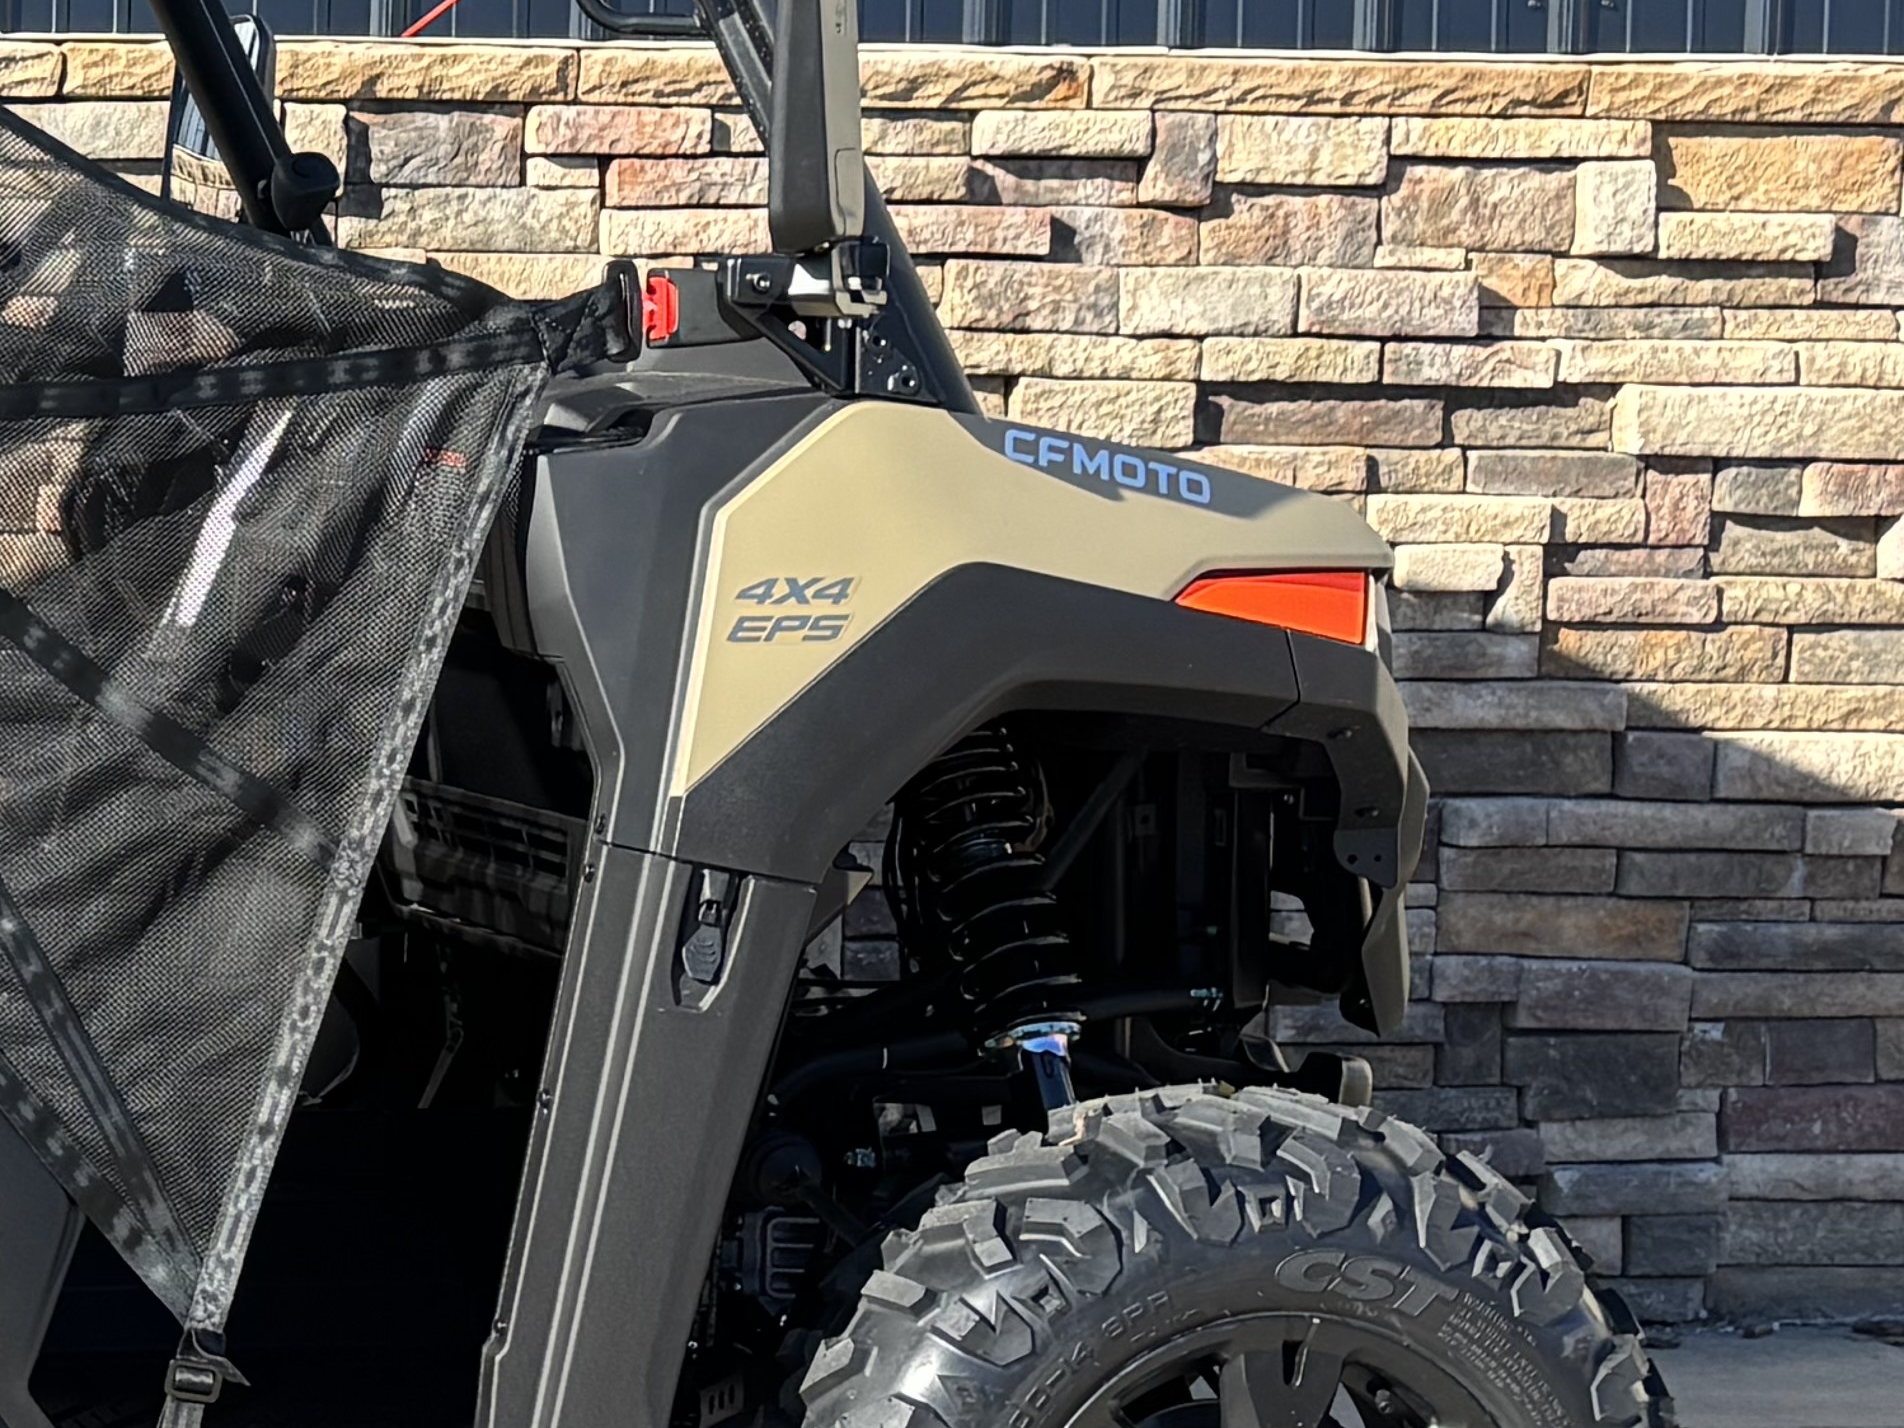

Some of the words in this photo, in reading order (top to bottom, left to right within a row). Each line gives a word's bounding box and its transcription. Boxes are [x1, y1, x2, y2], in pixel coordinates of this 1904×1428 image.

[1003, 429, 1212, 504] CFMOTO
[735, 576, 855, 606] 4X4
[725, 613, 852, 643] EPS
[1273, 1247, 1460, 1318] CST
